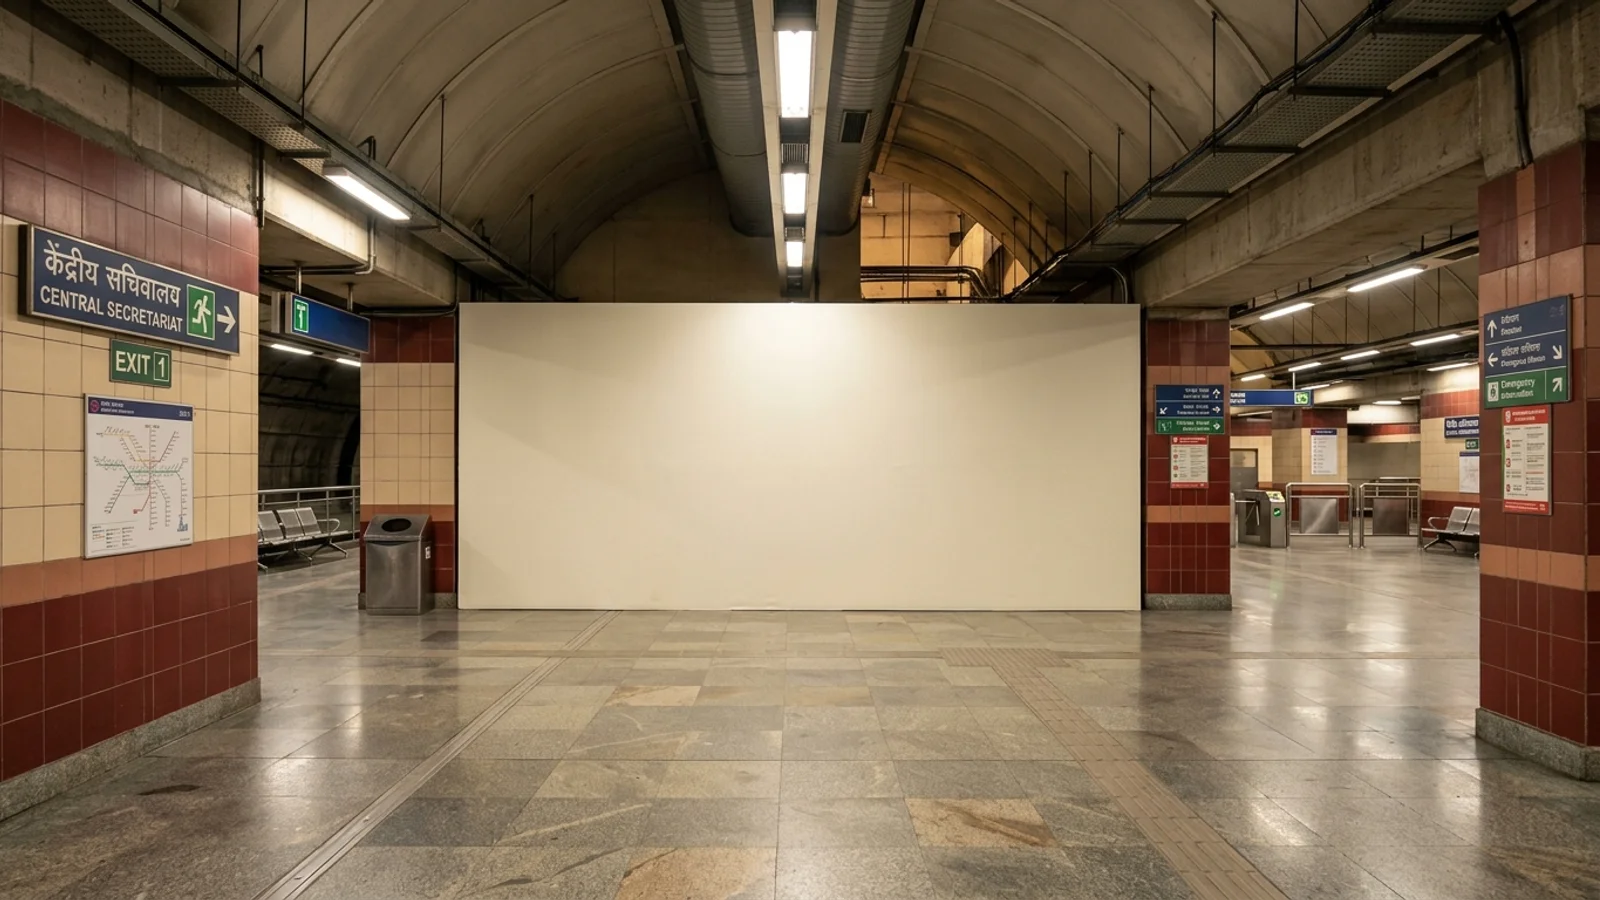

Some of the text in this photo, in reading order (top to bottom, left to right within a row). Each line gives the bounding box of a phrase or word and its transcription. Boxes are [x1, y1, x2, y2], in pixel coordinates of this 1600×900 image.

[43, 239, 100, 286] केंद्रीय
[40, 285, 183, 333] CENTRAL SECRETARIAT
[115, 350, 165, 378] EXIT 1
